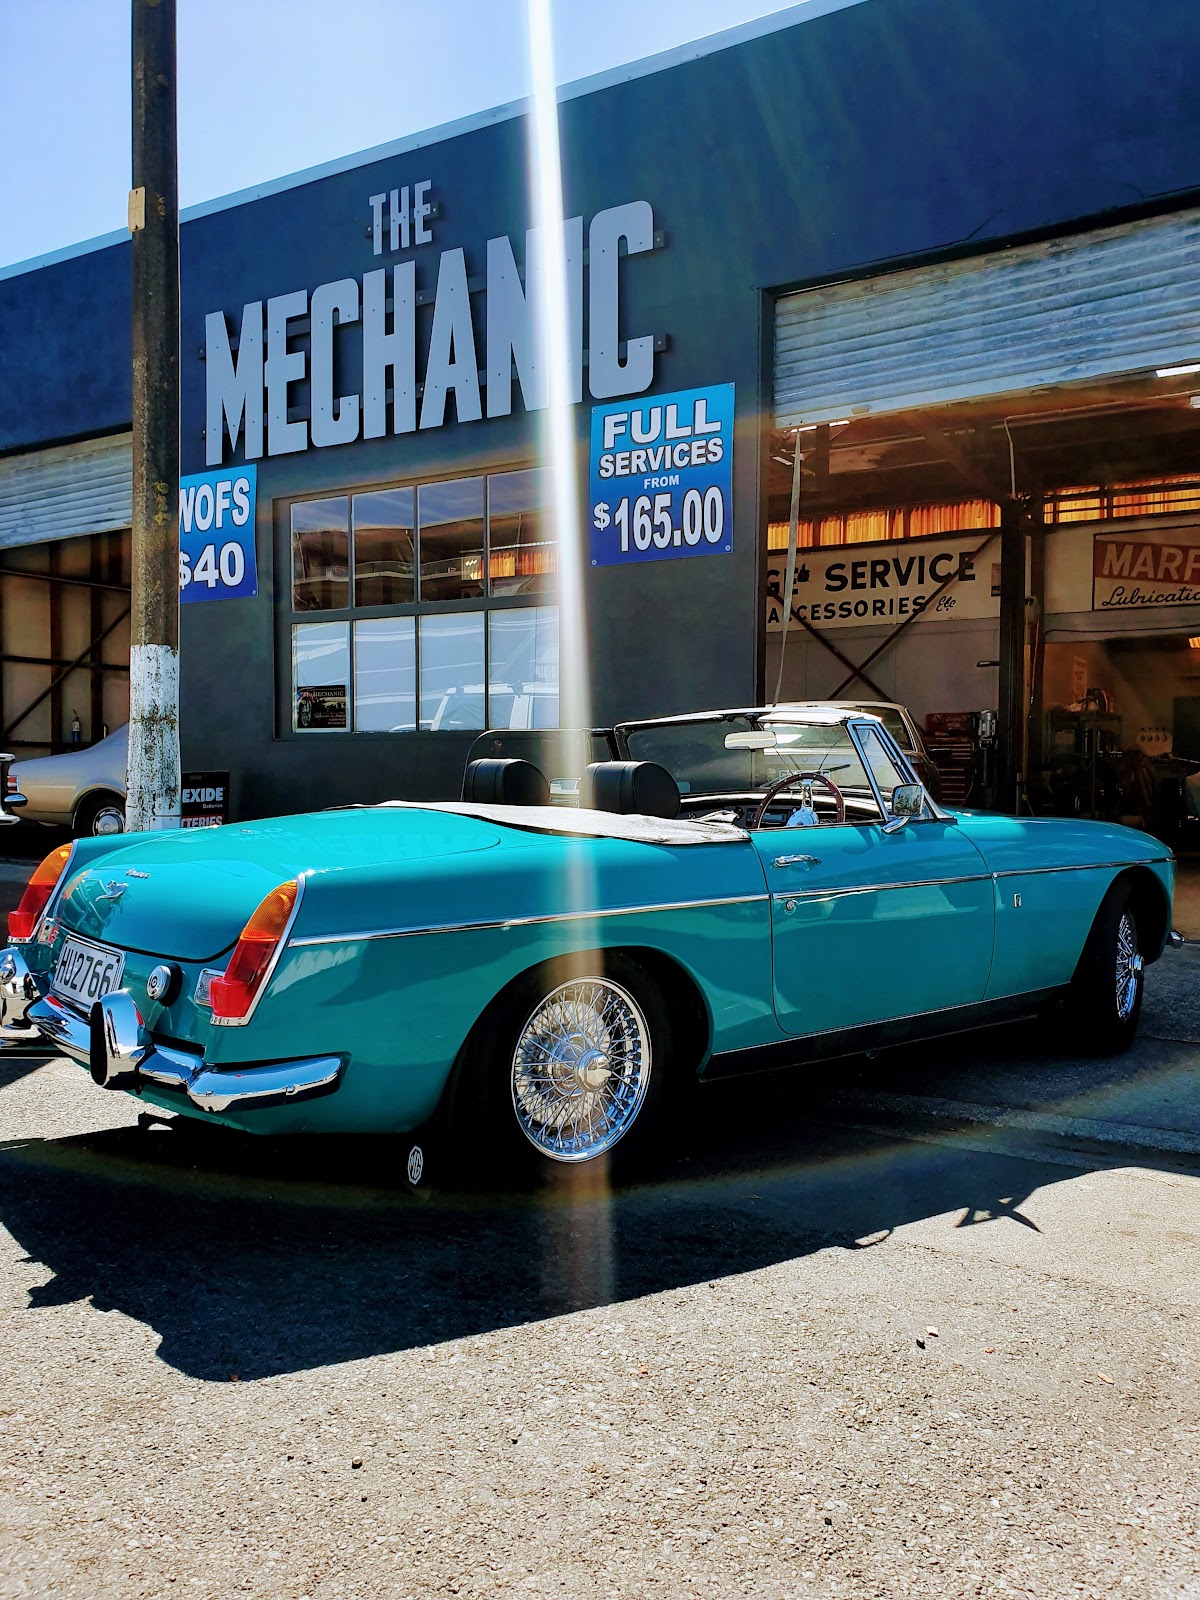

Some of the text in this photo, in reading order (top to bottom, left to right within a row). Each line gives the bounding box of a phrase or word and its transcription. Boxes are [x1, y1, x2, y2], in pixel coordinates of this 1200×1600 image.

[369, 179, 433, 256] THE
[205, 200, 654, 466] MECHANIC
[603, 399, 722, 450] FULL
[599, 437, 724, 479] SERVICES
[643, 475, 680, 489] FROM
[593, 486, 724, 552] $165.00
[824, 552, 976, 592] SERVICE
[767, 595, 927, 624] ACESSORIES
[182, 787, 224, 803] EXIDE
[55, 946, 114, 999] HU2766
